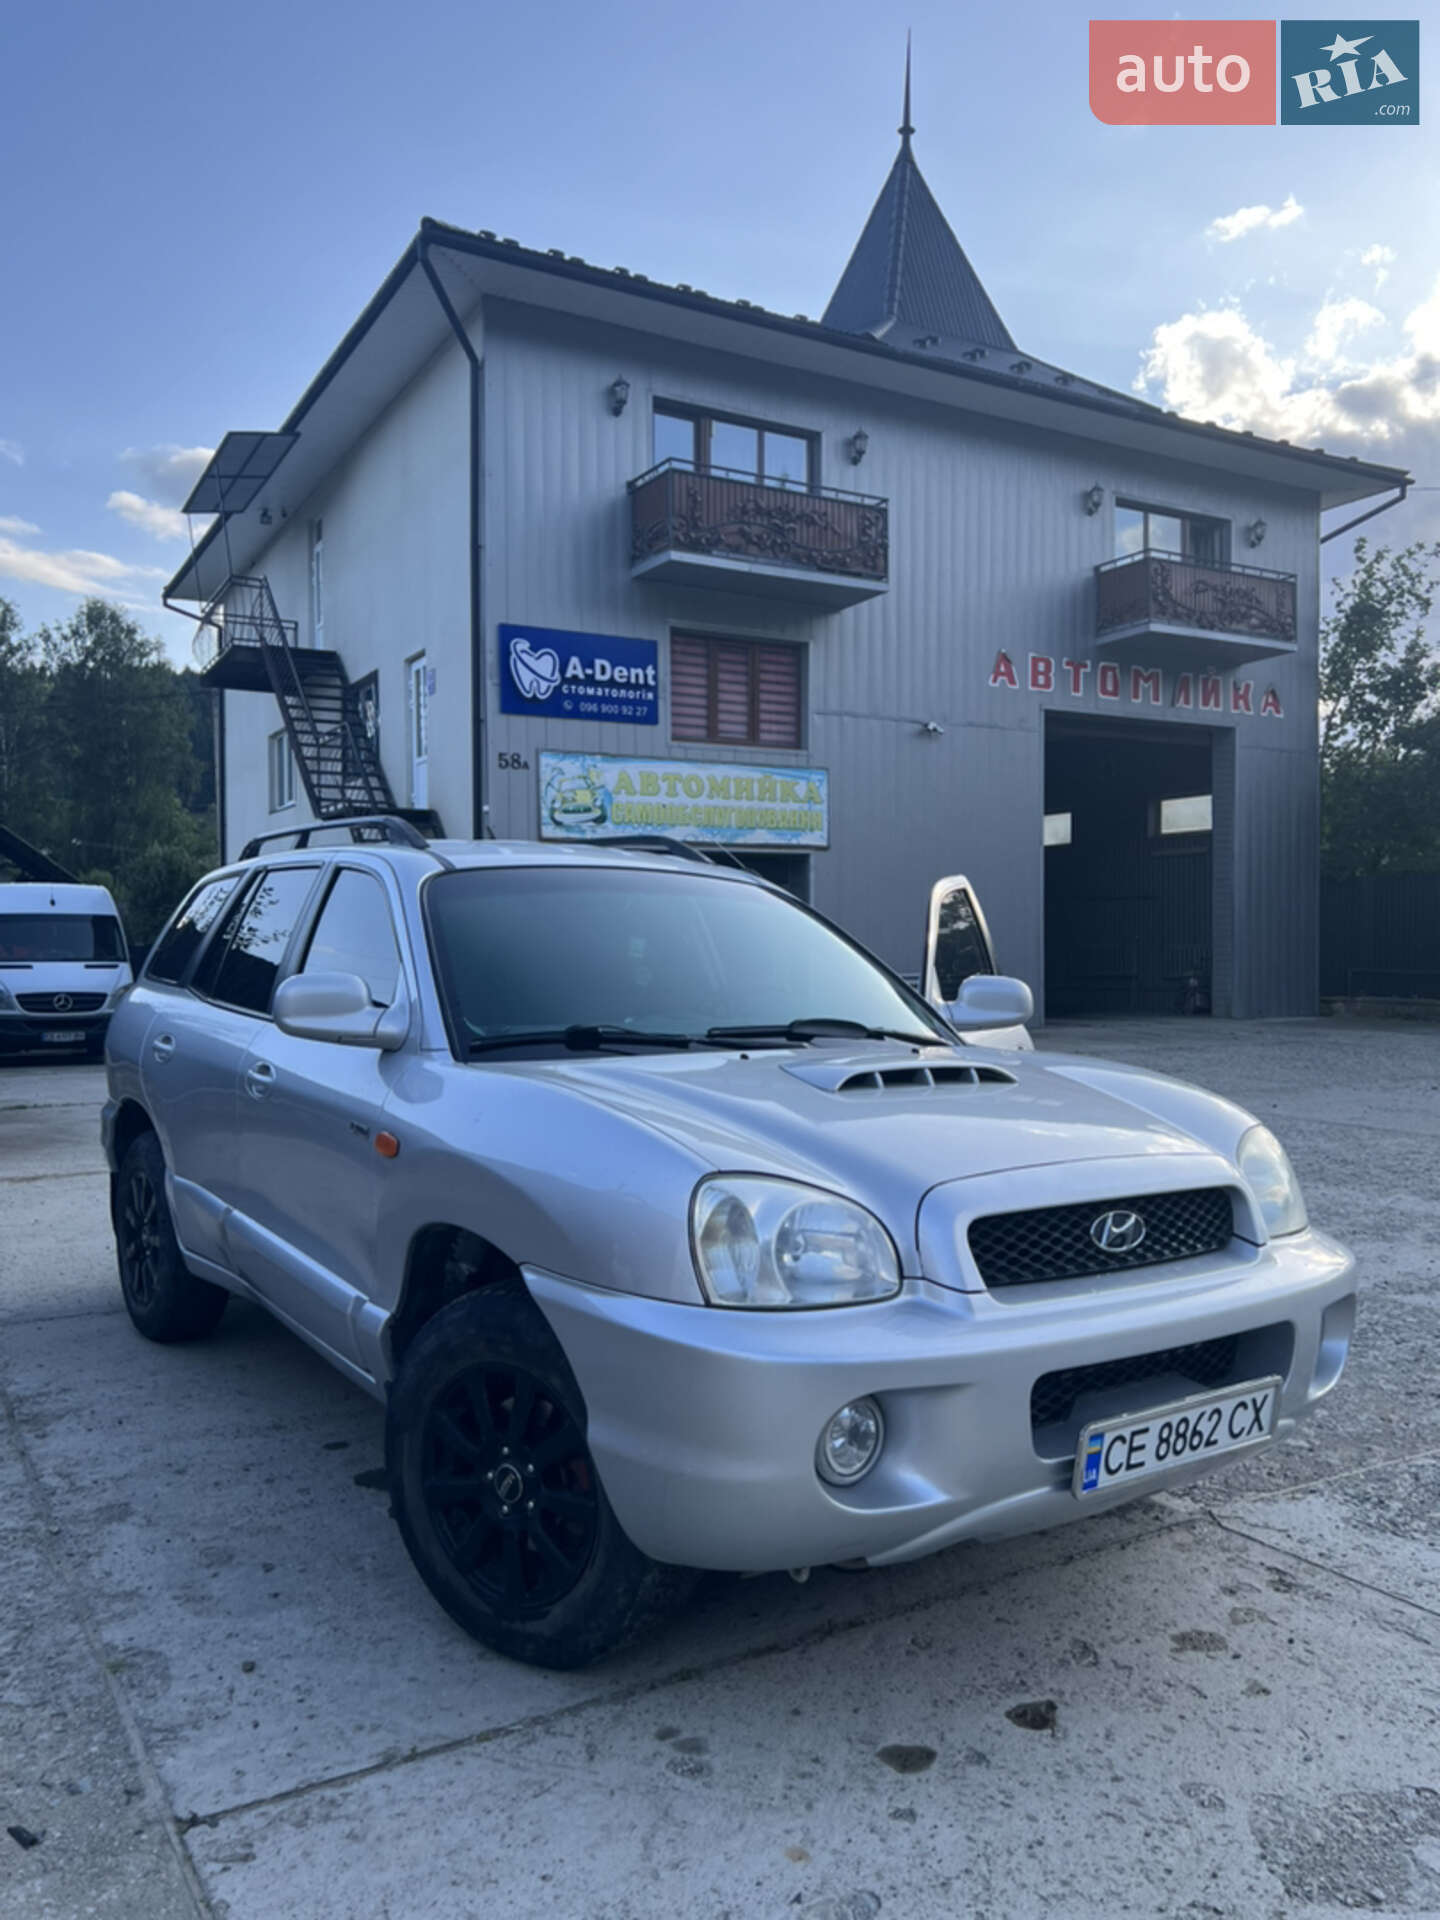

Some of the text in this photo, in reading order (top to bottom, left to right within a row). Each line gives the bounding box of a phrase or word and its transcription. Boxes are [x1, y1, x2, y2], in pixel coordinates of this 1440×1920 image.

[564, 655, 656, 686] A-Dent
[989, 649, 1284, 718] АВТОМИЙКА
[579, 701, 598, 713] 096
[612, 770, 823, 804] АВТОМИЙКА
[1104, 1394, 1269, 1476] CE 8862 CX
